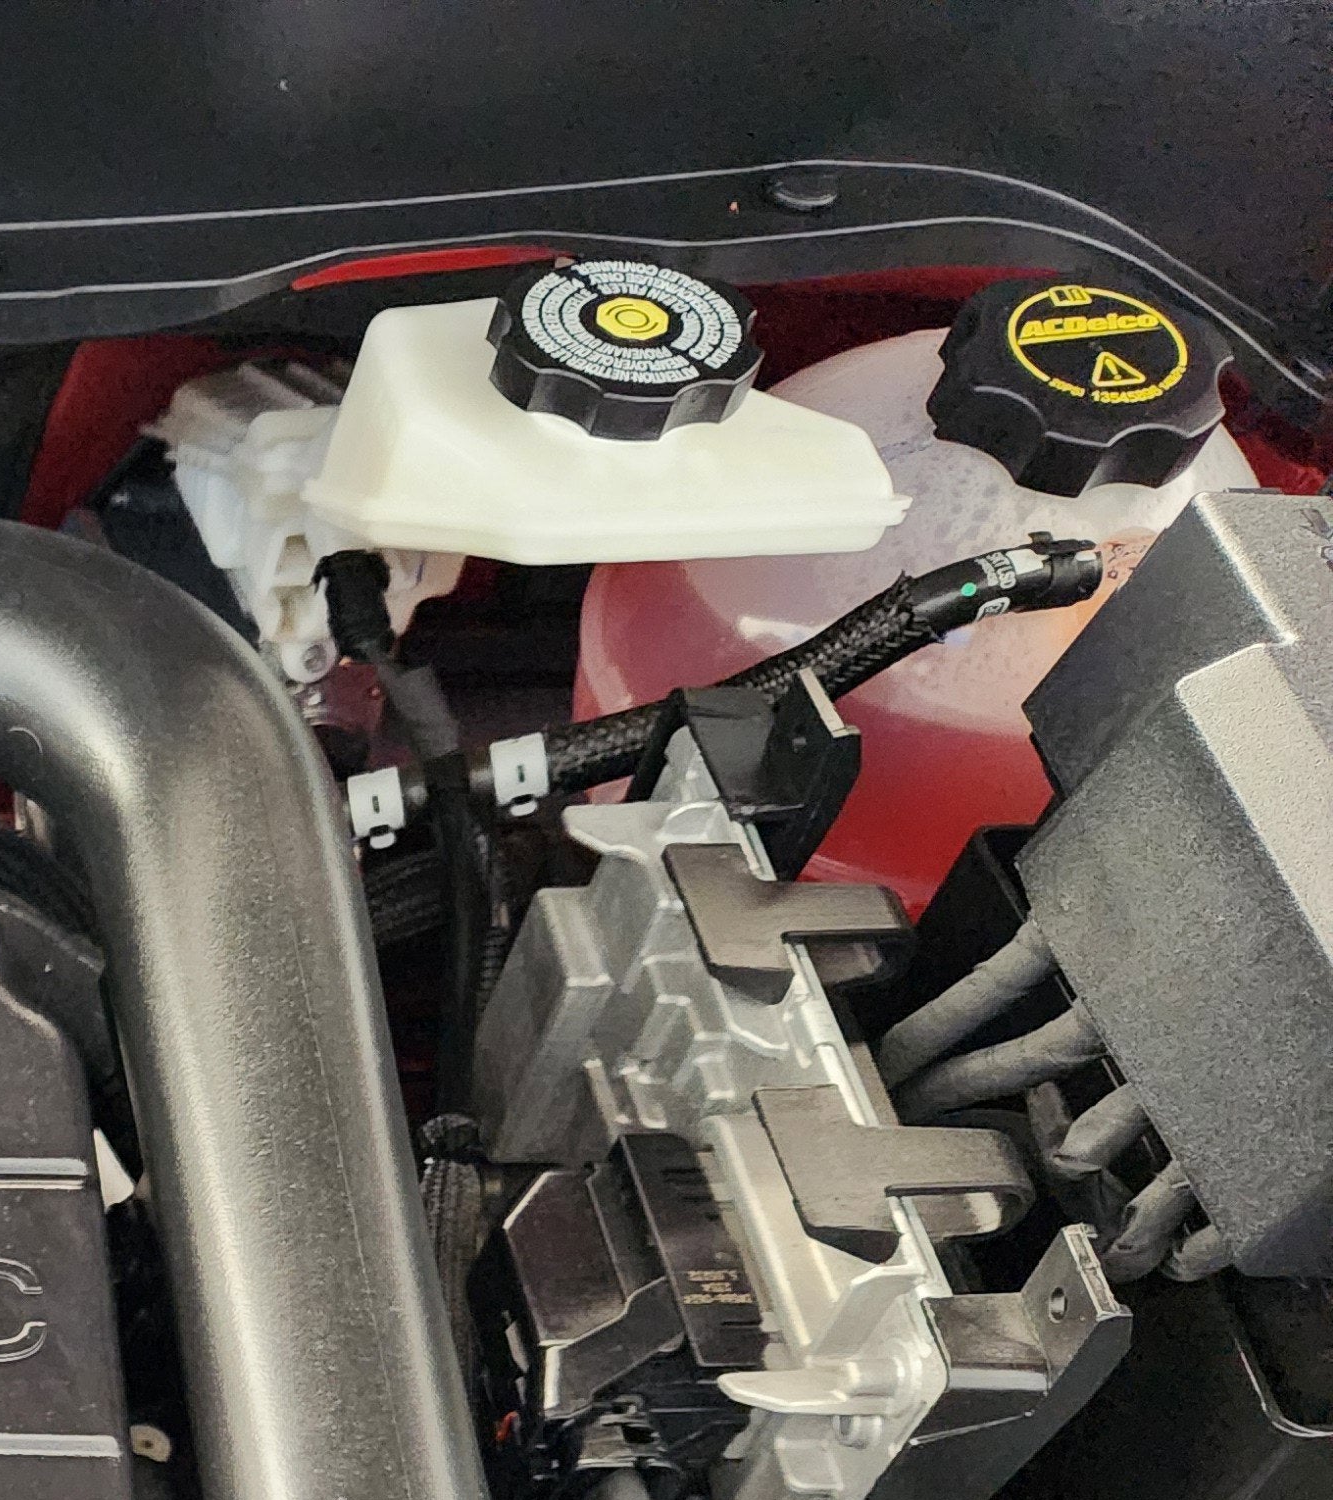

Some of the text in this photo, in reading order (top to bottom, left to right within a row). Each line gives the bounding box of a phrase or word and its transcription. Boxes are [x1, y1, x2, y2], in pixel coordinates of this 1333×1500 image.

[588, 272, 625, 286] ONLY
[658, 267, 715, 296] SEALED
[596, 283, 694, 313] CLEAN FILLER
[1020, 313, 1160, 339] ACDelco
[563, 355, 630, 383] NETTOYER
